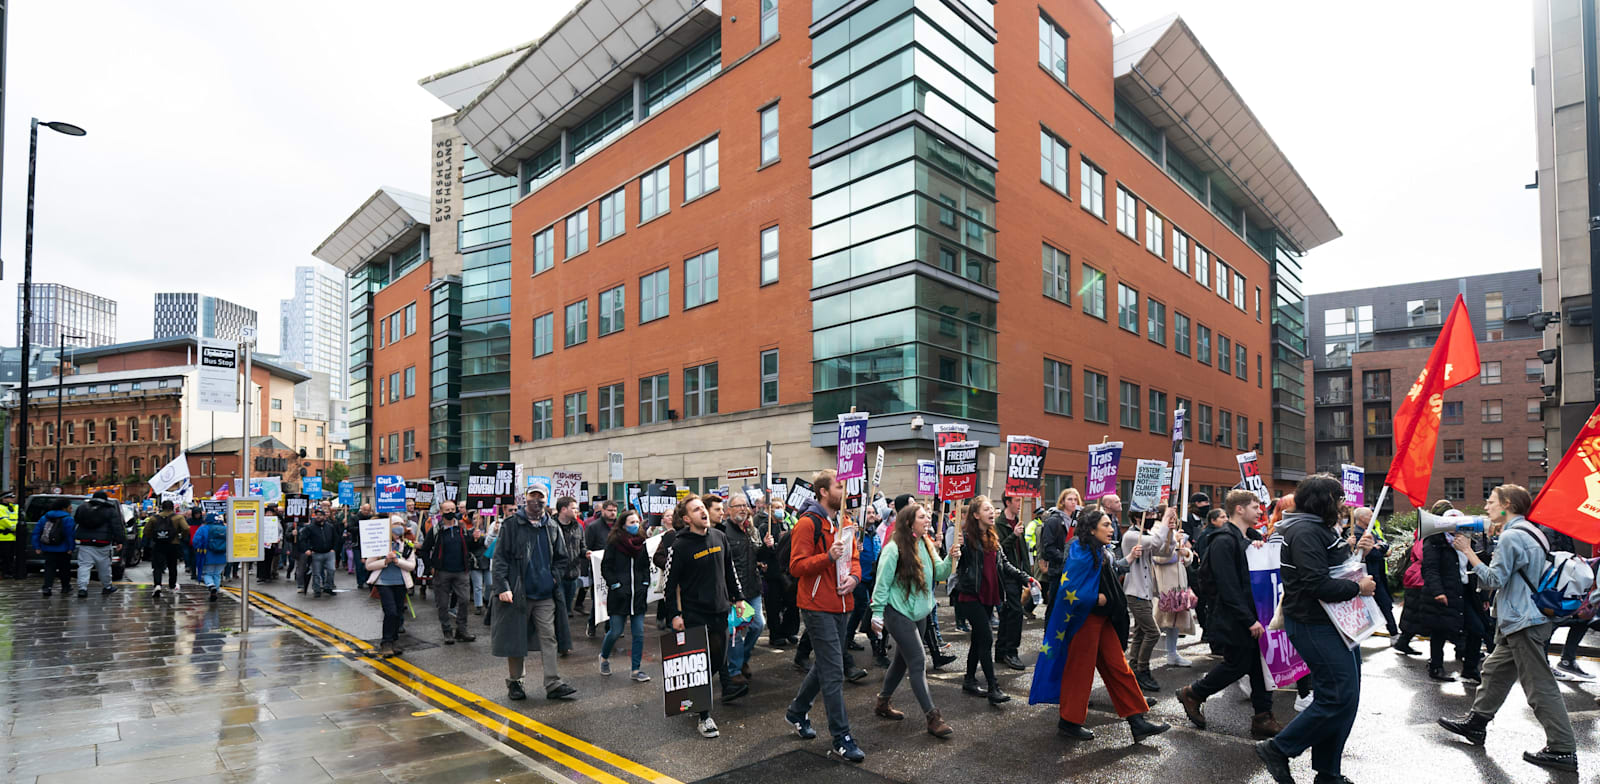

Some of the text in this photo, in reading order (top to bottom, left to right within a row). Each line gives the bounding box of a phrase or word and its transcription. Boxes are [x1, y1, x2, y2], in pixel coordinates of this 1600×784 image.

[436, 141, 444, 222] EVERSHEDS
[444, 138, 452, 221] SUTHERLAND
[204, 357, 234, 368] Bus Stop
[839, 422, 861, 439] Trans
[839, 438, 865, 460] Rights
[947, 449, 976, 461] FREEDOM
[1010, 443, 1045, 456] DEFY
[255, 456, 288, 472] RAIN
[1009, 454, 1043, 468] TORY
[1090, 451, 1113, 466] Trans
[919, 464, 936, 473] Trans
[945, 463, 977, 475] PALESTINE
[1008, 465, 1040, 479] RULE
[1090, 463, 1117, 482] Rights
[1243, 461, 1260, 477] DE
[377, 477, 392, 485] Cut
[469, 475, 495, 484] NOT FIT TO
[552, 471, 582, 481] MIDWIVES
[1137, 472, 1160, 480] CHANGE
[1343, 470, 1360, 482] Trans
[467, 484, 495, 495] GOVERN
[495, 479, 513, 496] UT
[556, 480, 577, 489] SAY
[1245, 475, 1262, 491] TO
[1343, 480, 1363, 494] Rights
[554, 488, 577, 498] FAIR
[650, 496, 661, 505] NOT
[661, 496, 669, 504] FIT
[286, 505, 307, 516] OUT
[663, 652, 708, 679] GOVERN
[664, 670, 709, 692] NOT FIT TO
